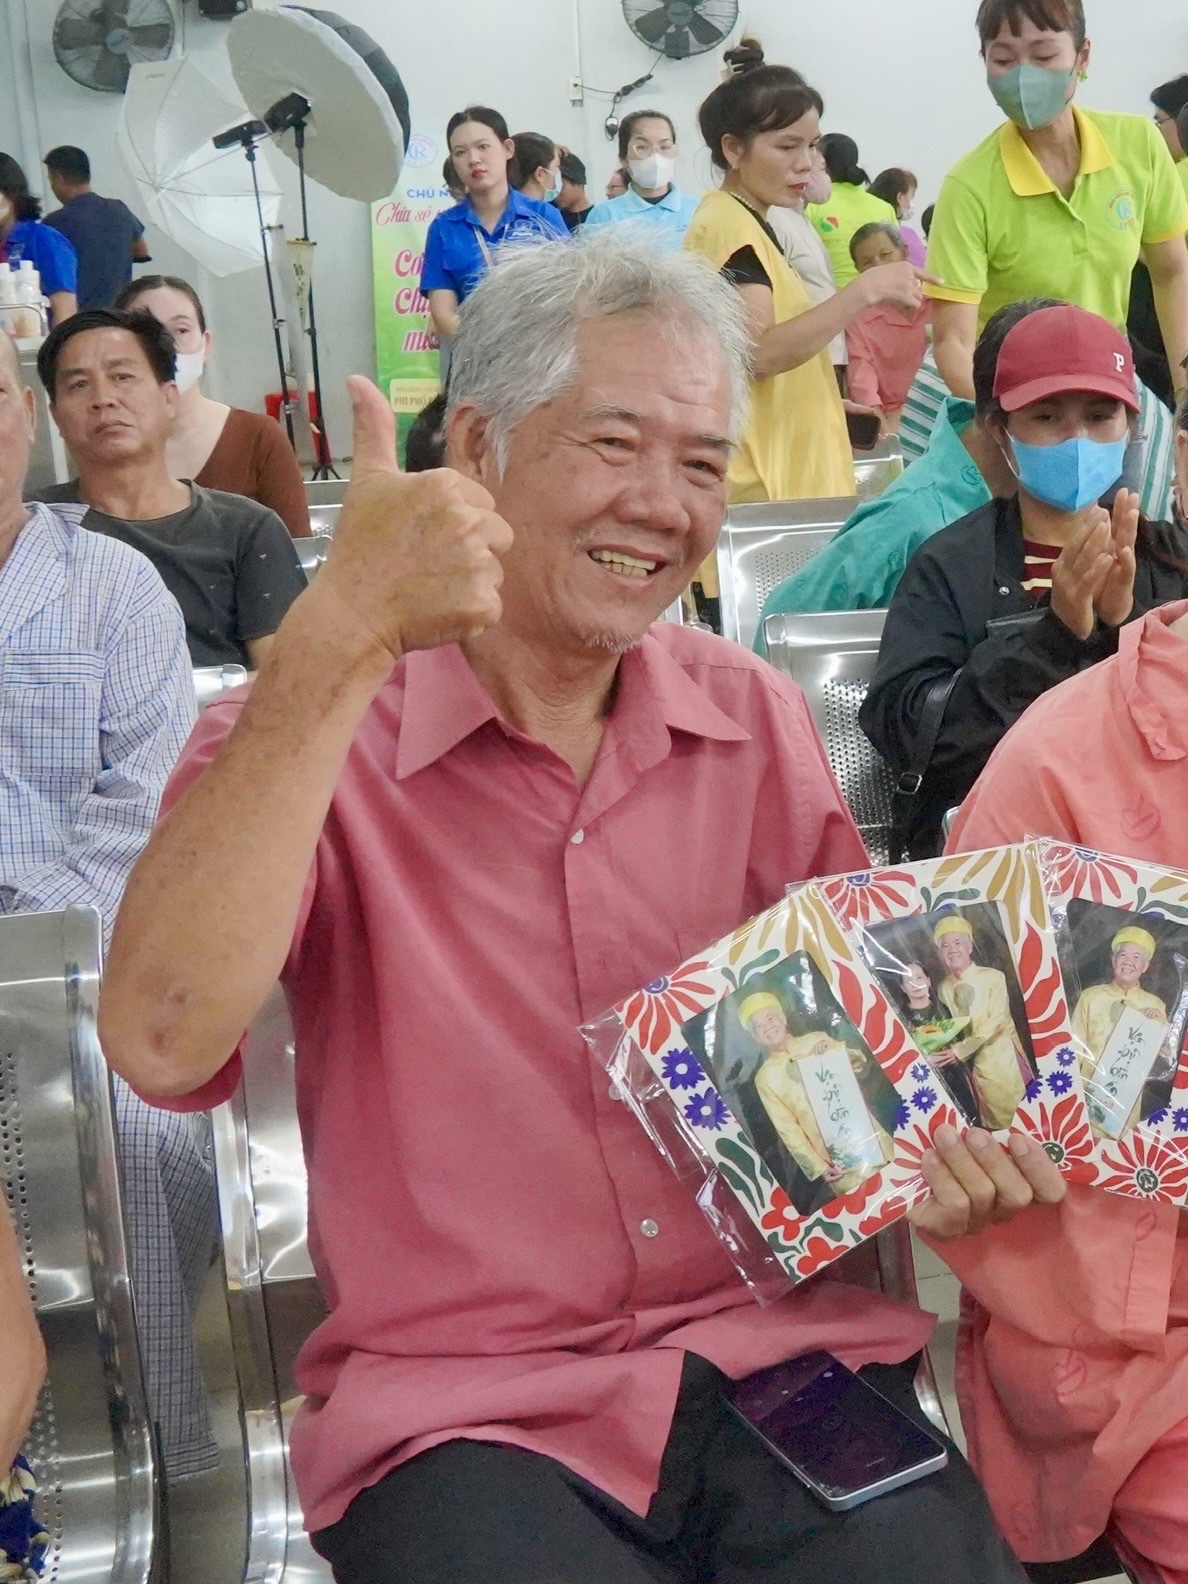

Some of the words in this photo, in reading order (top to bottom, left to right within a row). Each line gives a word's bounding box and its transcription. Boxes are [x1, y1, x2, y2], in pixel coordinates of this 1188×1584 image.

[407, 186, 435, 198] CHỦ
[376, 201, 411, 226] Chia
[1112, 352, 1125, 373] P
